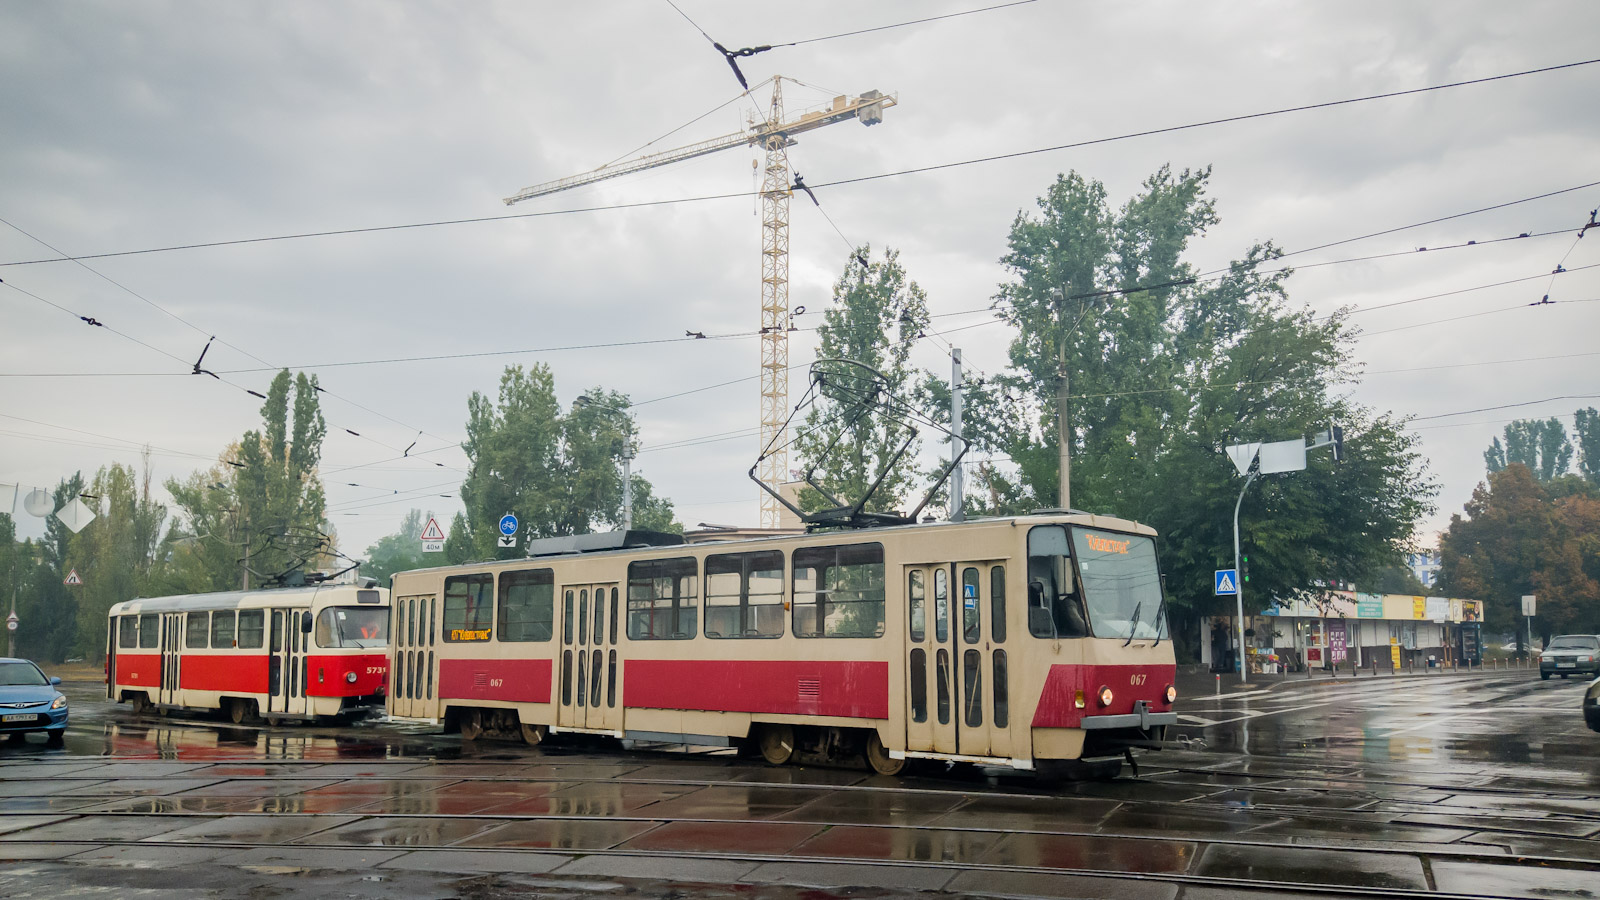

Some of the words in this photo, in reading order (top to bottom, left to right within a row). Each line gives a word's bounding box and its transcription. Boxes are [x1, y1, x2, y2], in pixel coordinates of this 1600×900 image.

[366, 666, 386, 674] 5731
[490, 678, 503, 687] 067
[1130, 674, 1147, 686] 067
